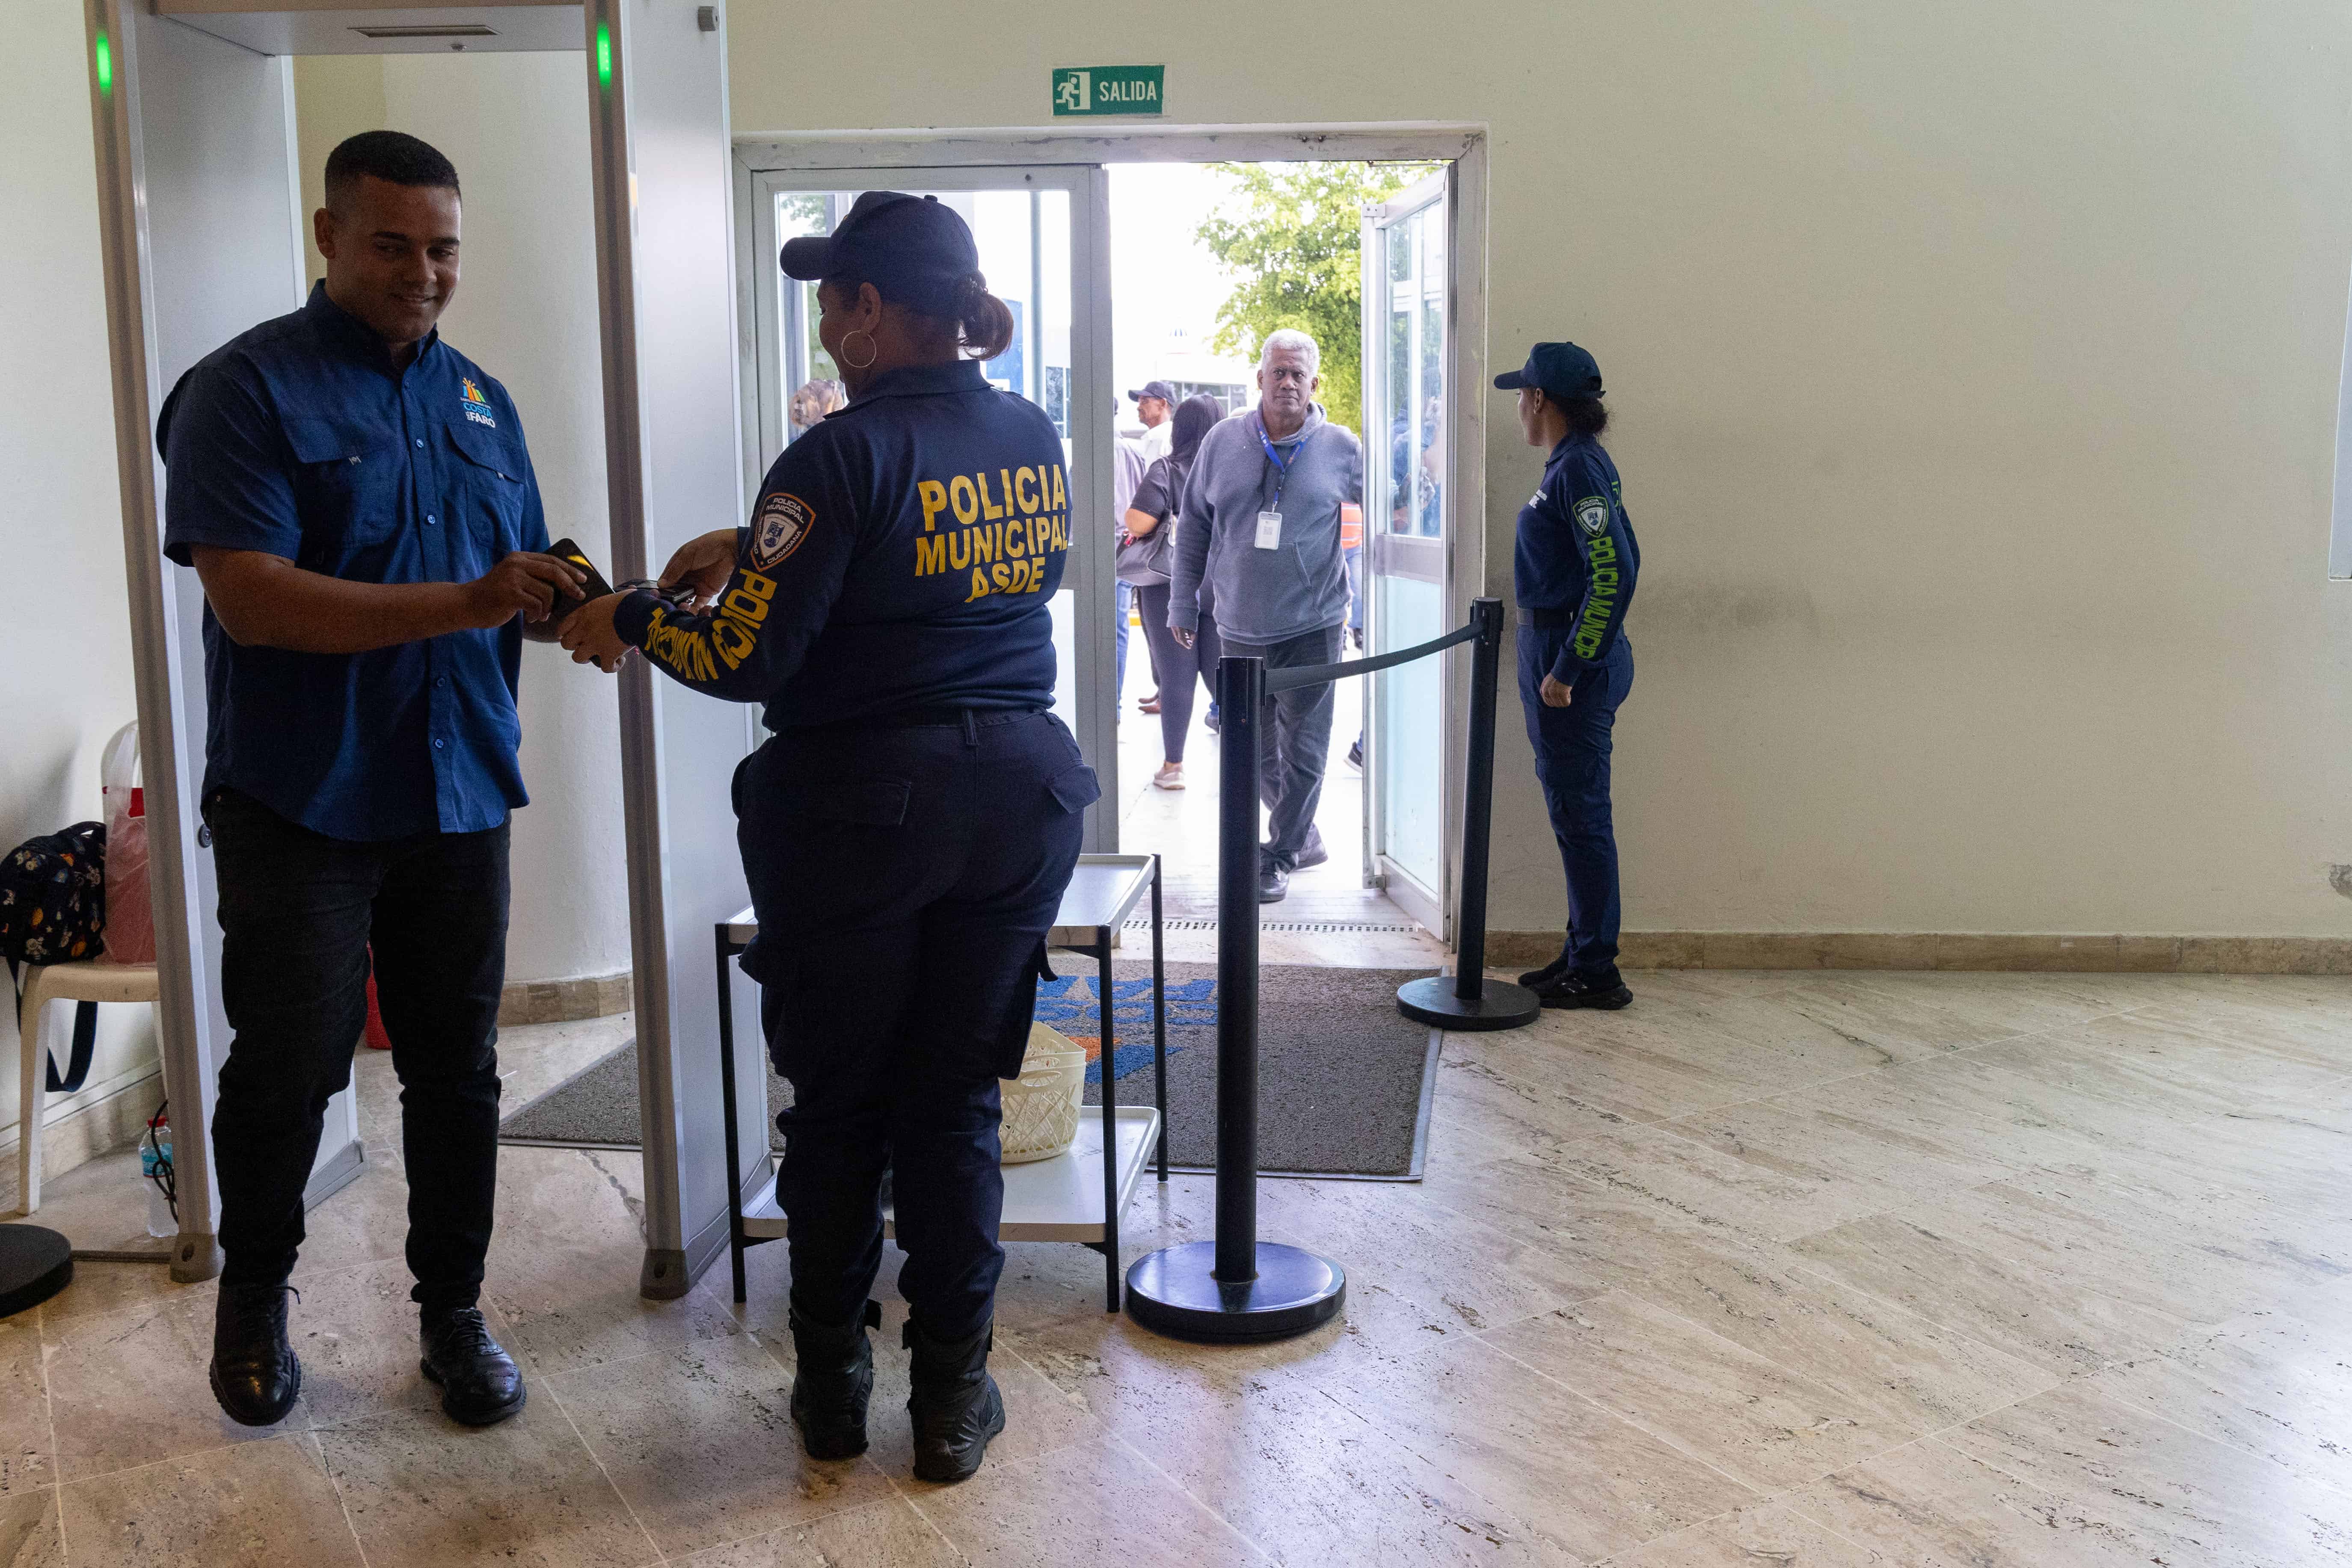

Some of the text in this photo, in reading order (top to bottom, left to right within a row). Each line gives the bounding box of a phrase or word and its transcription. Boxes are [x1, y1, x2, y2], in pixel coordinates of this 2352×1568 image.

[1099, 81, 1157, 101] SALIDA
[463, 402, 492, 418] COSTA
[470, 412, 495, 428] FARO
[773, 498, 801, 513] POLICIA
[917, 464, 1066, 531] POLICIA
[766, 504, 804, 524] MUNICIPAL
[767, 531, 802, 564] CIUDADANA
[914, 515, 1068, 577] MUNICIPAL
[1587, 536, 1619, 596] POLICIA
[965, 557, 1045, 603] ASDE
